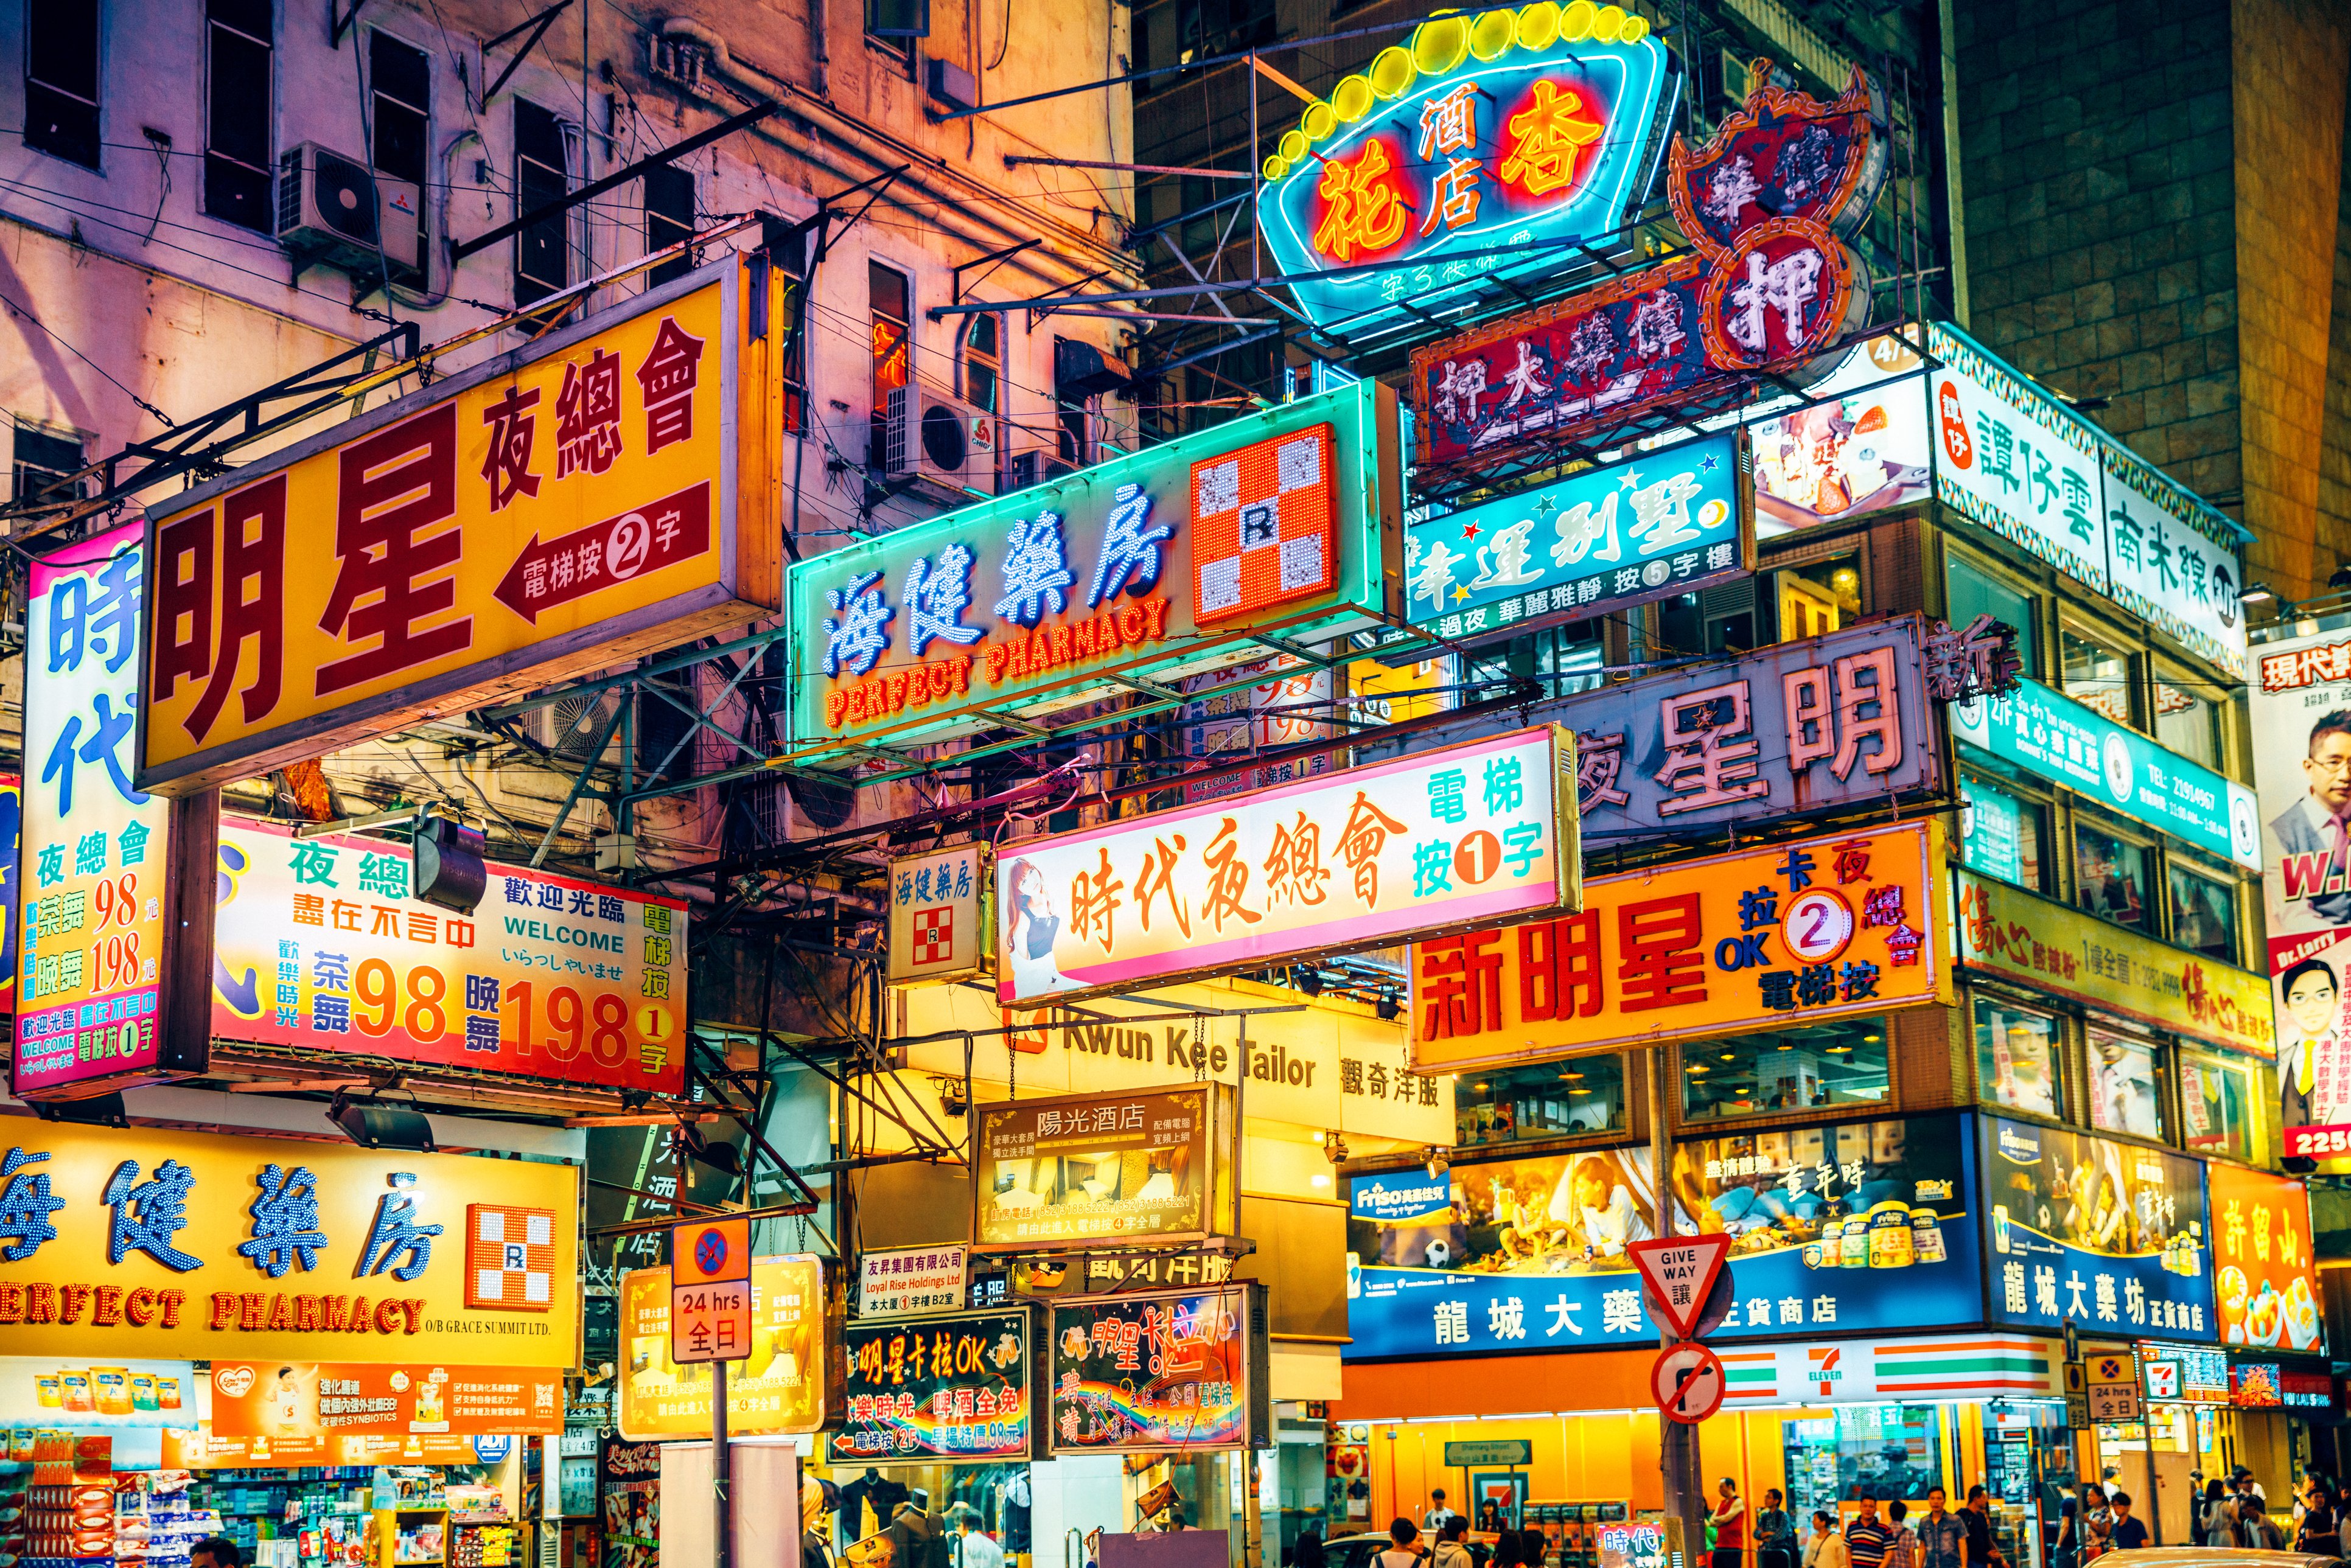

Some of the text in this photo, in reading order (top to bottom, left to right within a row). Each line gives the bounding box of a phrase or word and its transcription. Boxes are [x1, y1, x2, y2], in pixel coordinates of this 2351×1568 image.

[1419, 82, 1481, 237] 酒店
[1501, 80, 1605, 197] 香
[1315, 139, 1406, 262] 花
[481, 315, 706, 513] 夜總會
[972, 438, 992, 451] CHIGO
[153, 401, 473, 745] 明星
[825, 598, 1170, 728] PERFECT PHARMACY
[1192, 773, 1241, 792] WELCOME
[1428, 756, 1522, 823] 電梯
[37, 820, 150, 888] 夜總會
[288, 841, 410, 900] 夜總
[1070, 790, 1408, 955] 時代夜總會
[38, 873, 159, 938] 茶舞 98 元
[504, 877, 625, 924] 歡迎光臨
[896, 860, 973, 906] 海健藥房
[293, 893, 475, 949] 盡在不言中
[504, 916, 624, 953] WELCOME
[90, 932, 139, 994] 198
[142, 958, 156, 982] 元
[276, 939, 301, 1028] 歡樂時光
[1421, 892, 1708, 1042] 新明星
[1759, 961, 1879, 1011] 電梯按
[22, 991, 157, 1040] 歡迎光臨 盡在不言中
[313, 950, 351, 1033] 茶舞
[355, 958, 447, 1044] 98
[505, 980, 629, 1068] 198
[21, 1034, 74, 1059] WELCOME
[1063, 1009, 1316, 1087] Kwun Kee Tailor
[1340, 1058, 1439, 1107] 觀奇洋服
[993, 1132, 1035, 1145] 豪華大套房
[1037, 1103, 1145, 1138] 陽光酒店
[1089, 1136, 1130, 1145] HOTEL
[1153, 1117, 1190, 1131] 配備電腦
[2296, 1130, 2351, 1155] 225
[1166, 1195, 1190, 1208] 5221
[1357, 1183, 1402, 1208] Friso
[1018, 1221, 1074, 1236] 請由此進入
[868, 1252, 962, 1276] 友昇集團有限公司
[1661, 1250, 1696, 1265] GIVE
[1663, 1266, 1696, 1280] WAY
[683, 1292, 740, 1314] 24 hrs
[867, 1274, 960, 1295] Loyal Rise Holdings Ltd
[1672, 1284, 1691, 1306] 讓
[0, 1282, 427, 1335] ERFECT PHARMACY
[426, 1319, 551, 1336] O/B GRACE SUMMIT LTD.
[1433, 1289, 1643, 1345] 龍城大藥
[689, 1320, 736, 1353] 全日
[933, 1386, 1019, 1419] 啤酒全免
[1061, 1368, 1081, 1442] 聘請
[2096, 1386, 2131, 1398] 24 hrs
[1605, 1529, 1657, 1552] 時代
